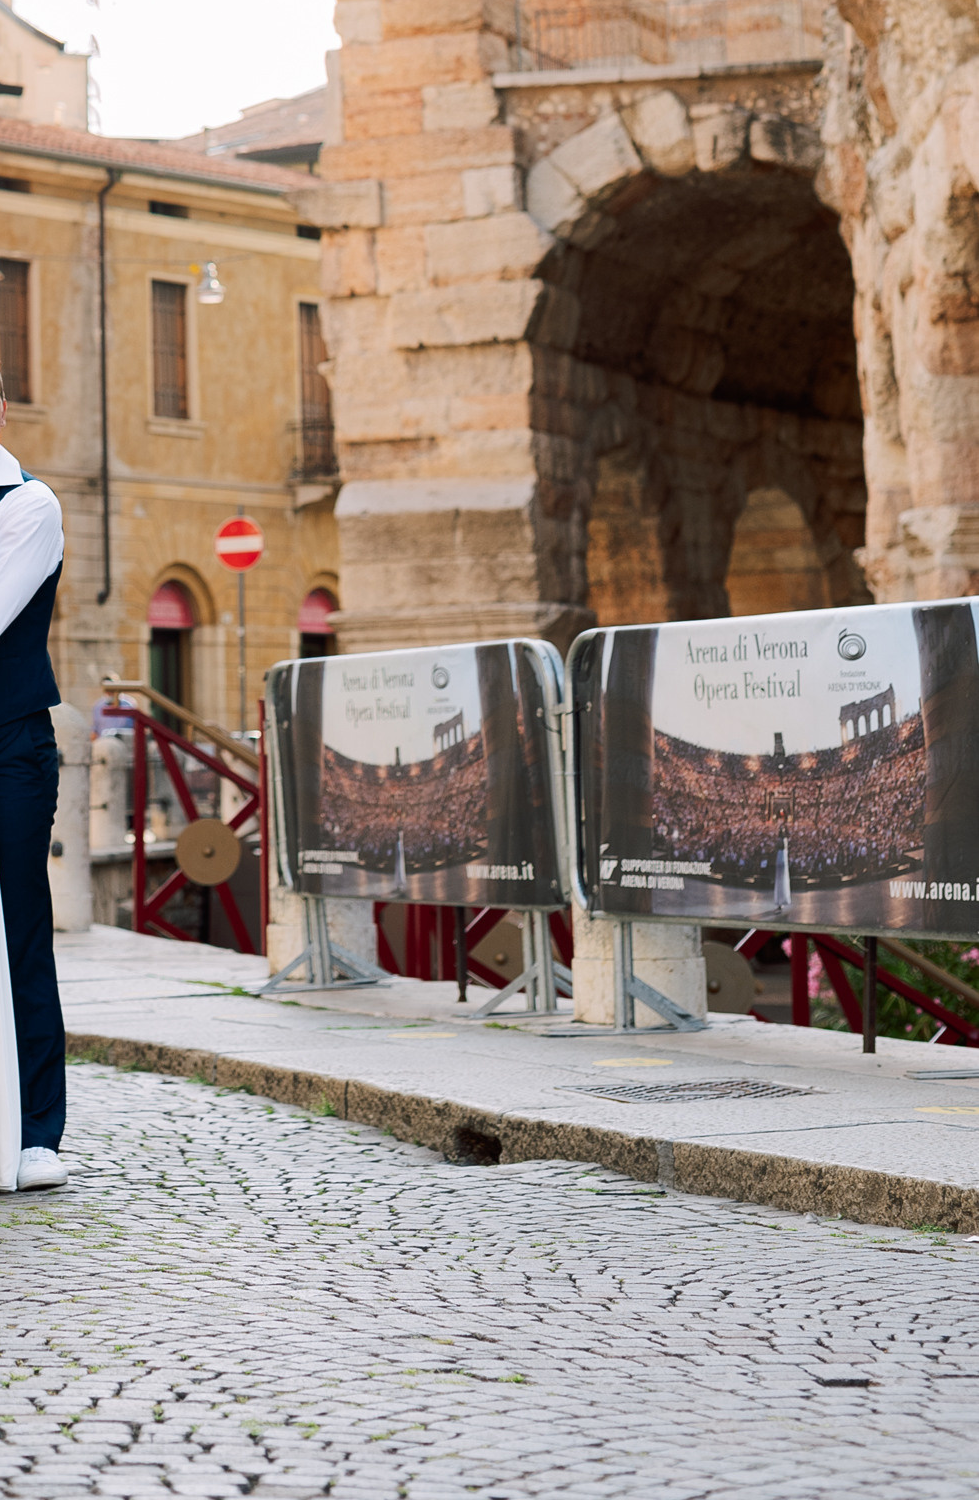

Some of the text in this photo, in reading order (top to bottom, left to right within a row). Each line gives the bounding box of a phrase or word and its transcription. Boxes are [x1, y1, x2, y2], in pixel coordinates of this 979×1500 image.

[686, 632, 809, 664] Arena di Verona
[341, 672, 368, 692] Arena
[371, 668, 379, 690] di
[693, 669, 801, 709] Opera Festival
[827, 683, 847, 692] ARENA
[621, 859, 664, 873] SUPPORTER
[620, 875, 685, 890] ARENA DI VERONA
